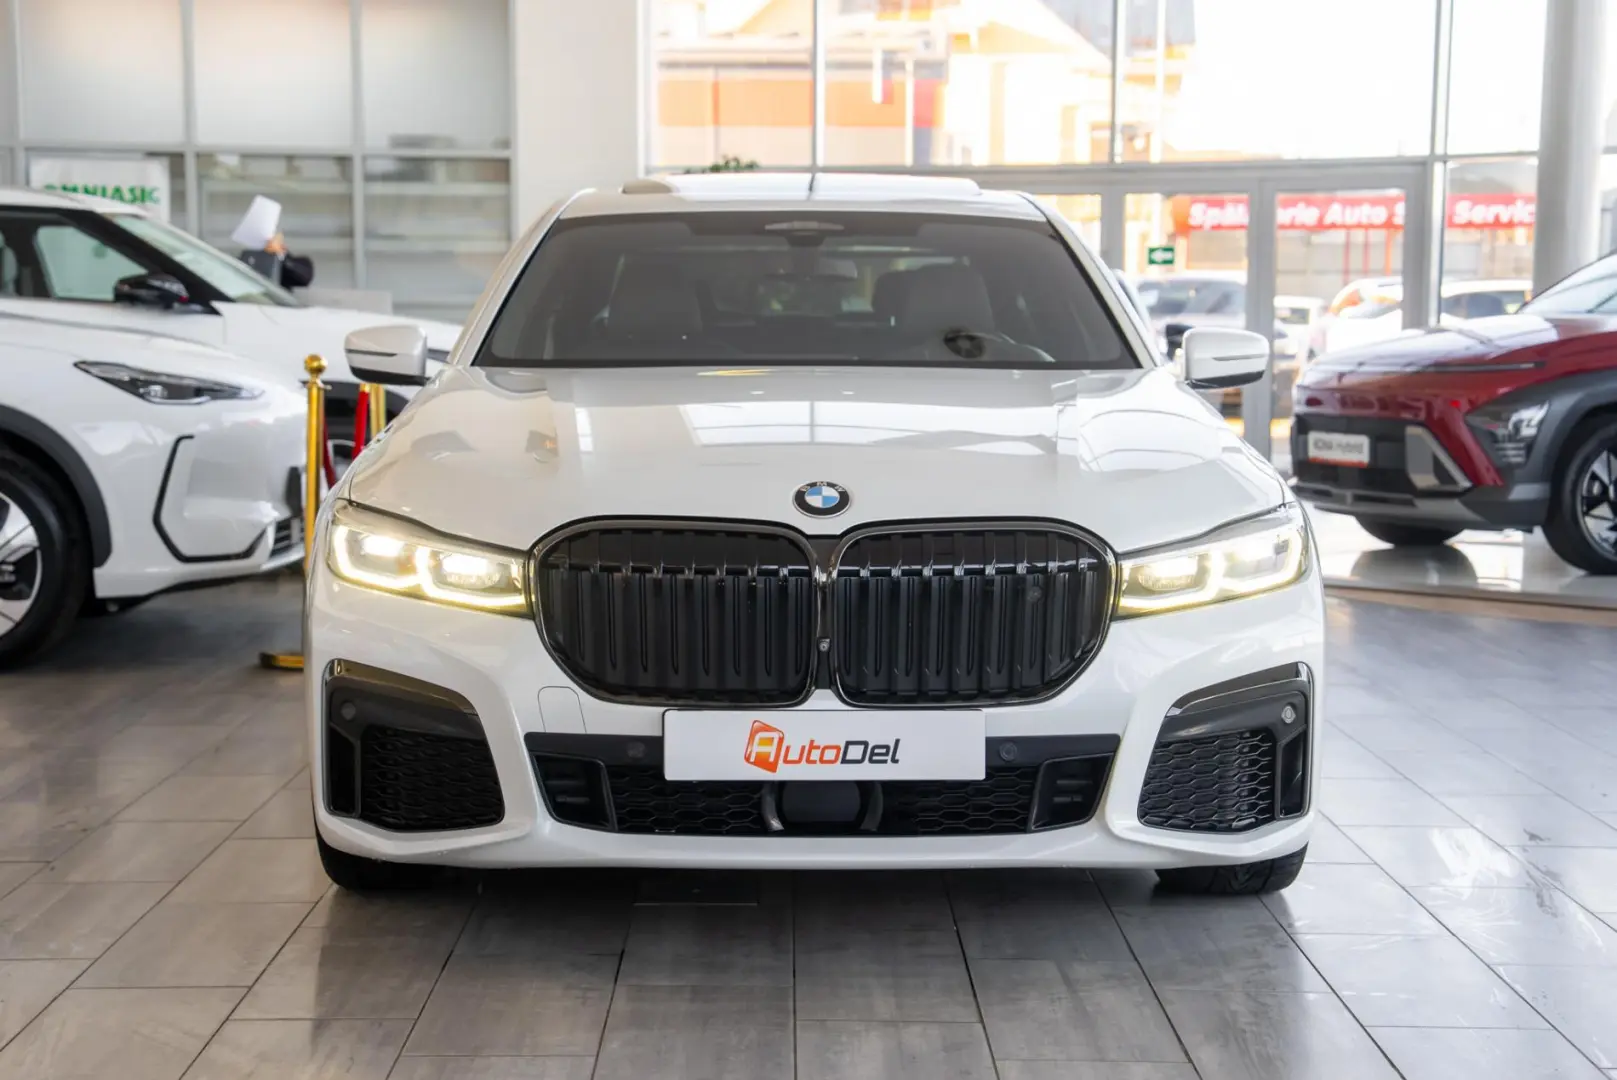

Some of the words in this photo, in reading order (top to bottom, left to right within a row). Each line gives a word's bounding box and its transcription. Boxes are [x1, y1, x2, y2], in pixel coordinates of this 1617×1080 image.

[1323, 202, 1389, 226] Auto
[1453, 199, 1535, 224] Servic
[746, 725, 901, 768] AutoDel
